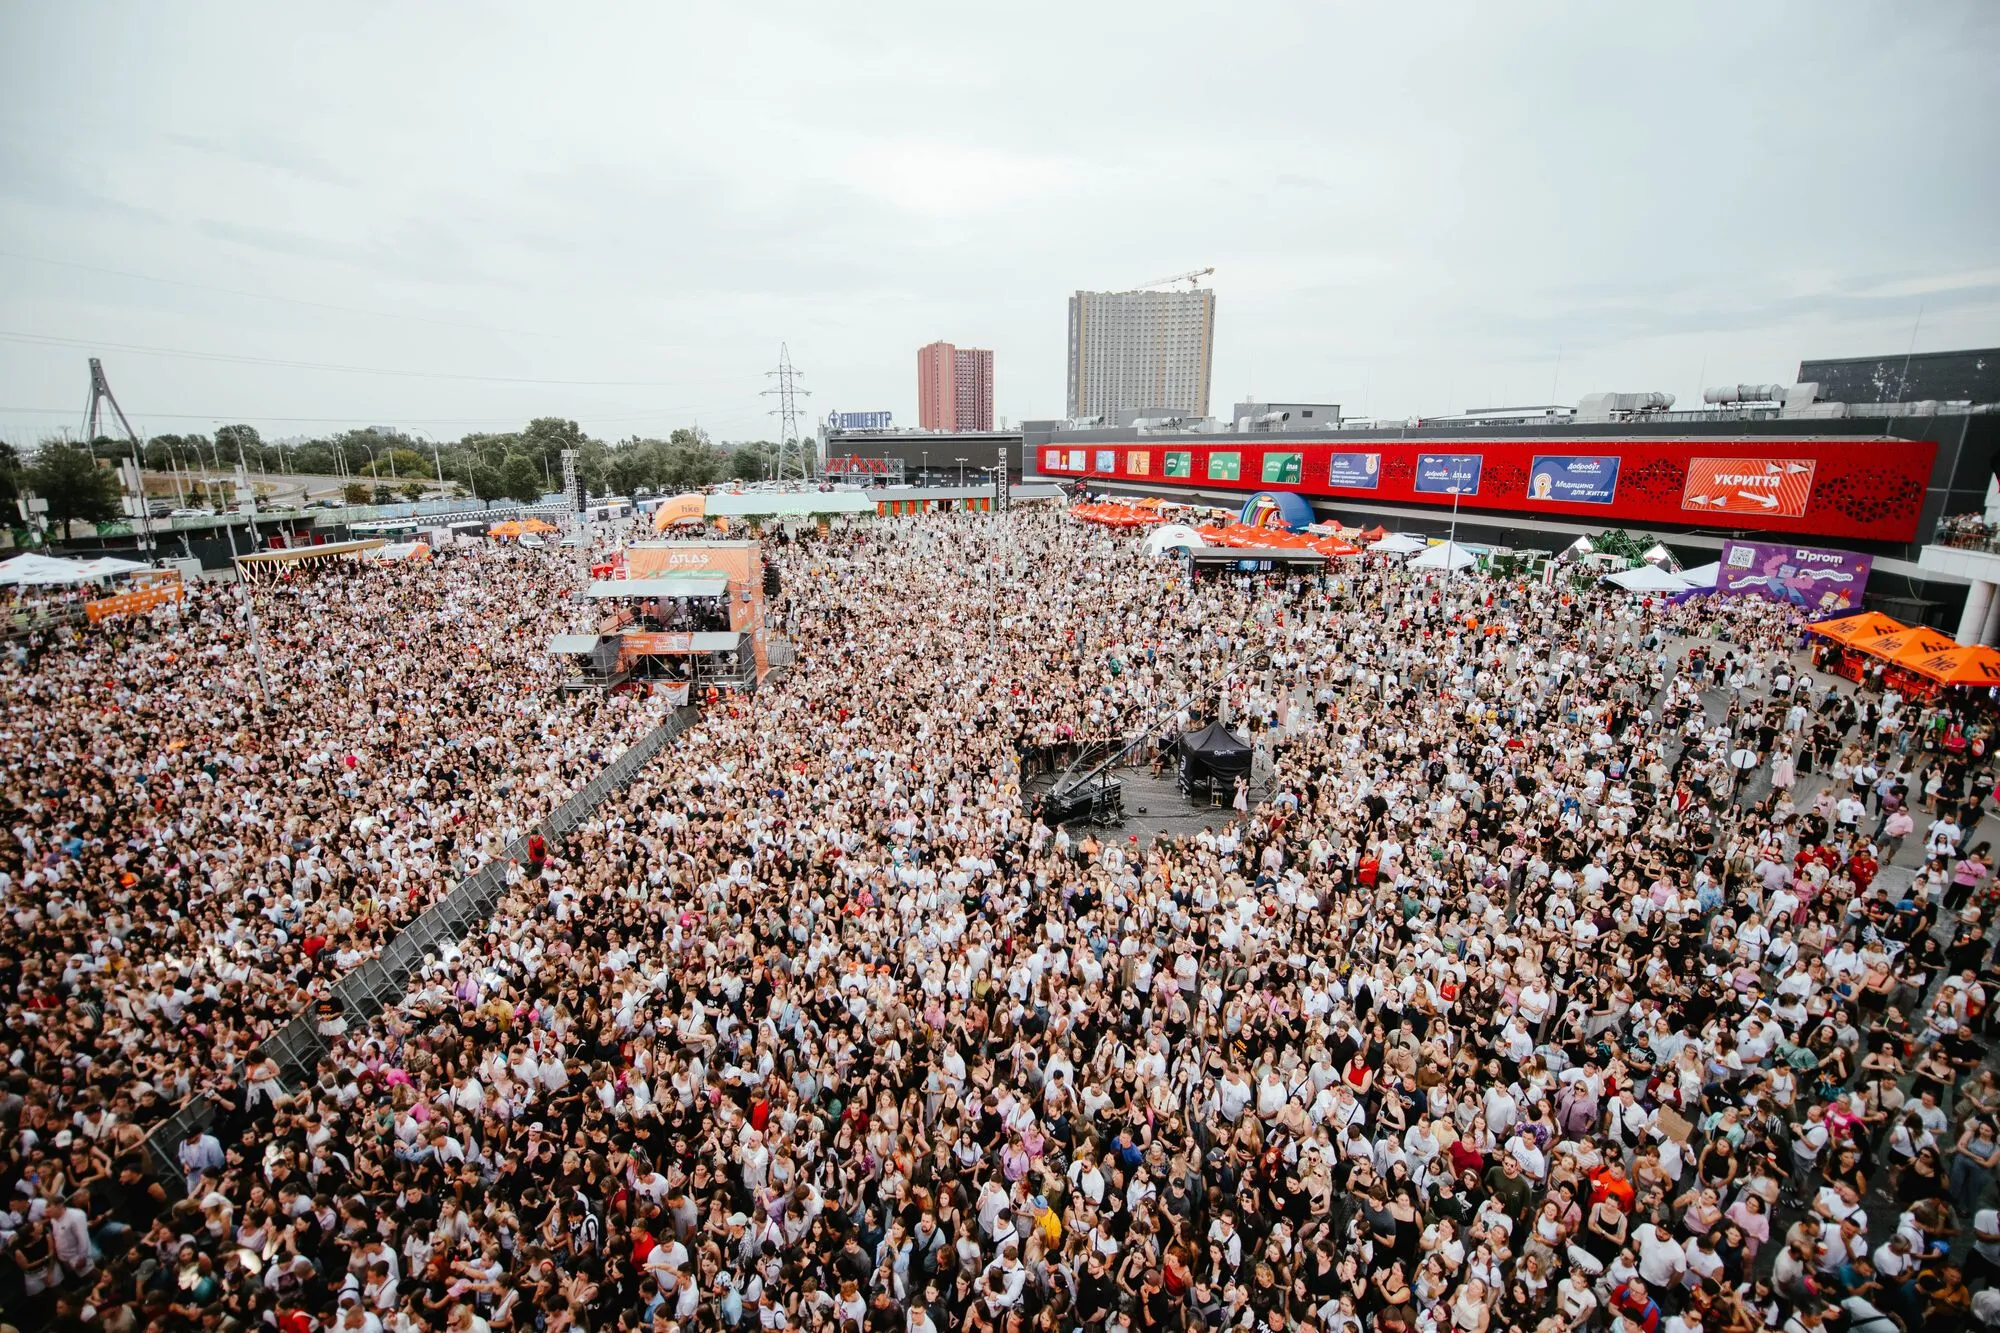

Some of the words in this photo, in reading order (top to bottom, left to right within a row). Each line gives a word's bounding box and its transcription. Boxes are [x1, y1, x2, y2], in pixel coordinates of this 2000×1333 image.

[1555, 480, 1594, 489] Медицина
[1714, 474, 1780, 488] УКРИТТЯ
[669, 551, 709, 564] ATLAS
[1808, 553, 1843, 564] prom
[1921, 654, 1958, 671] hike
